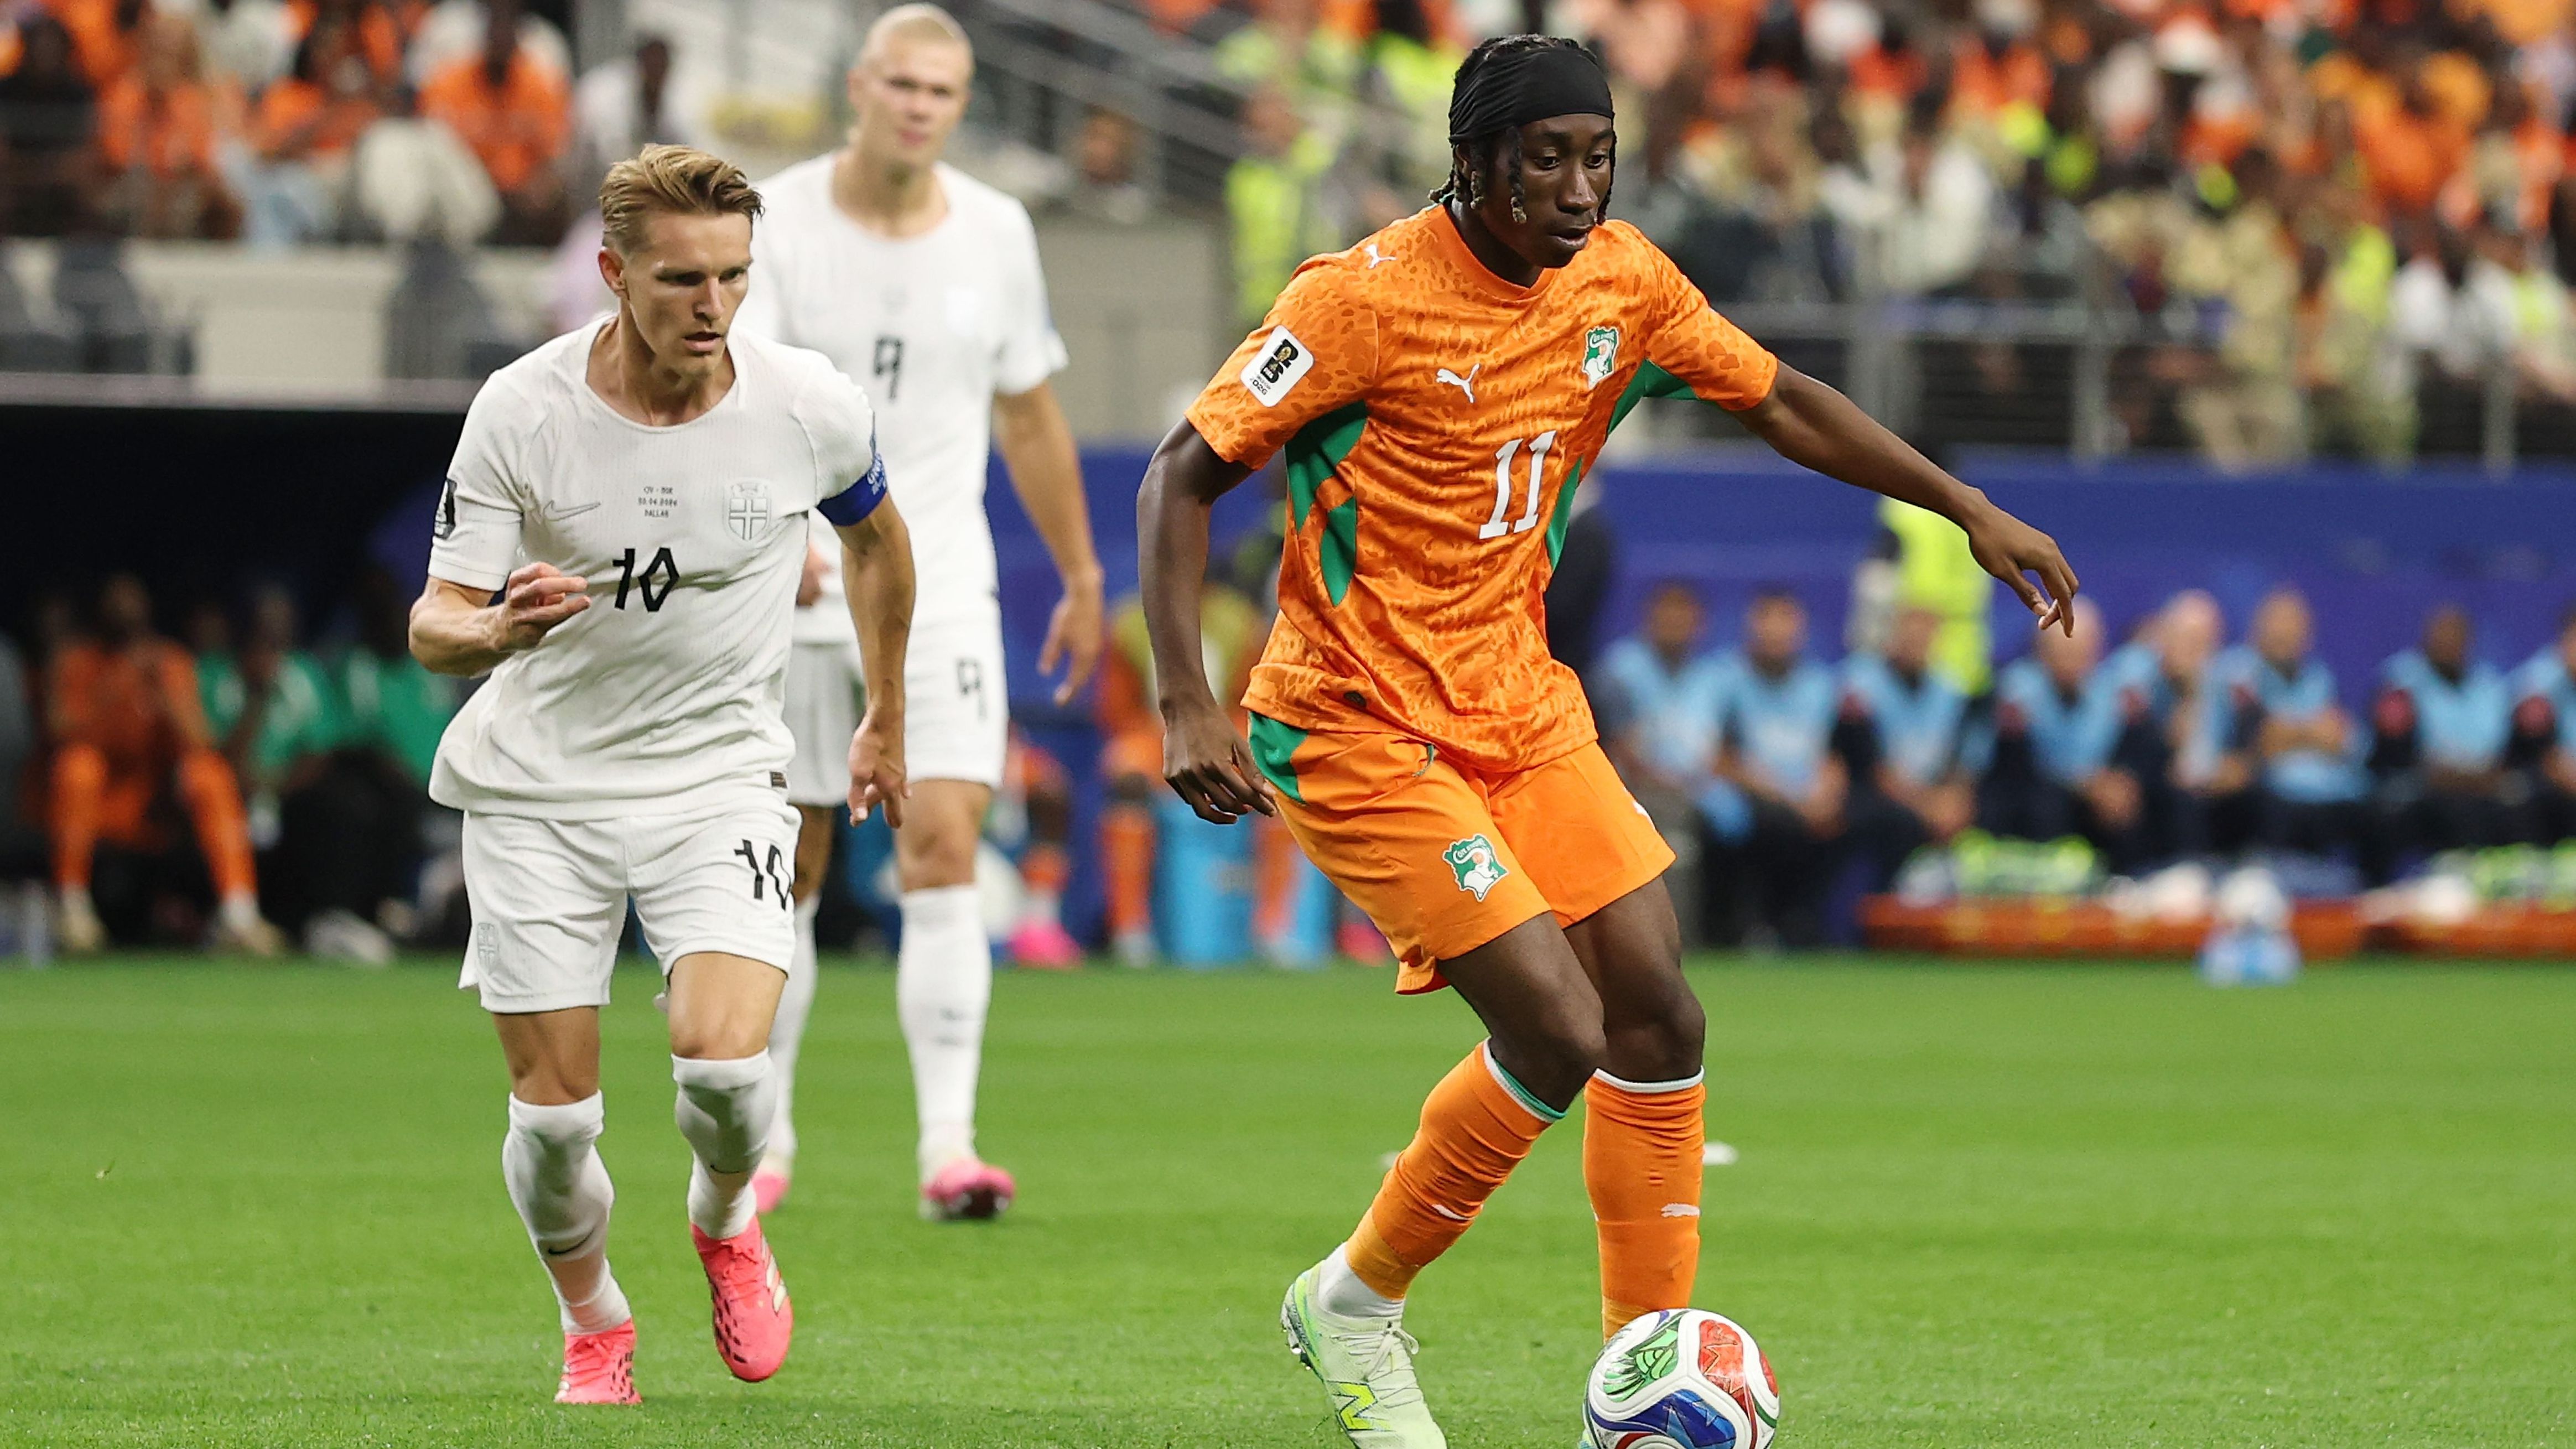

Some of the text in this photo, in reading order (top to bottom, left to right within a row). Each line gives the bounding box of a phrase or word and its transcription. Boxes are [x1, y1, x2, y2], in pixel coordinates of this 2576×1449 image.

[874, 335, 903, 400] 9
[1479, 430, 1557, 540] 11
[612, 547, 680, 612] 10
[956, 657, 986, 722] 9
[734, 838, 792, 911] 10
